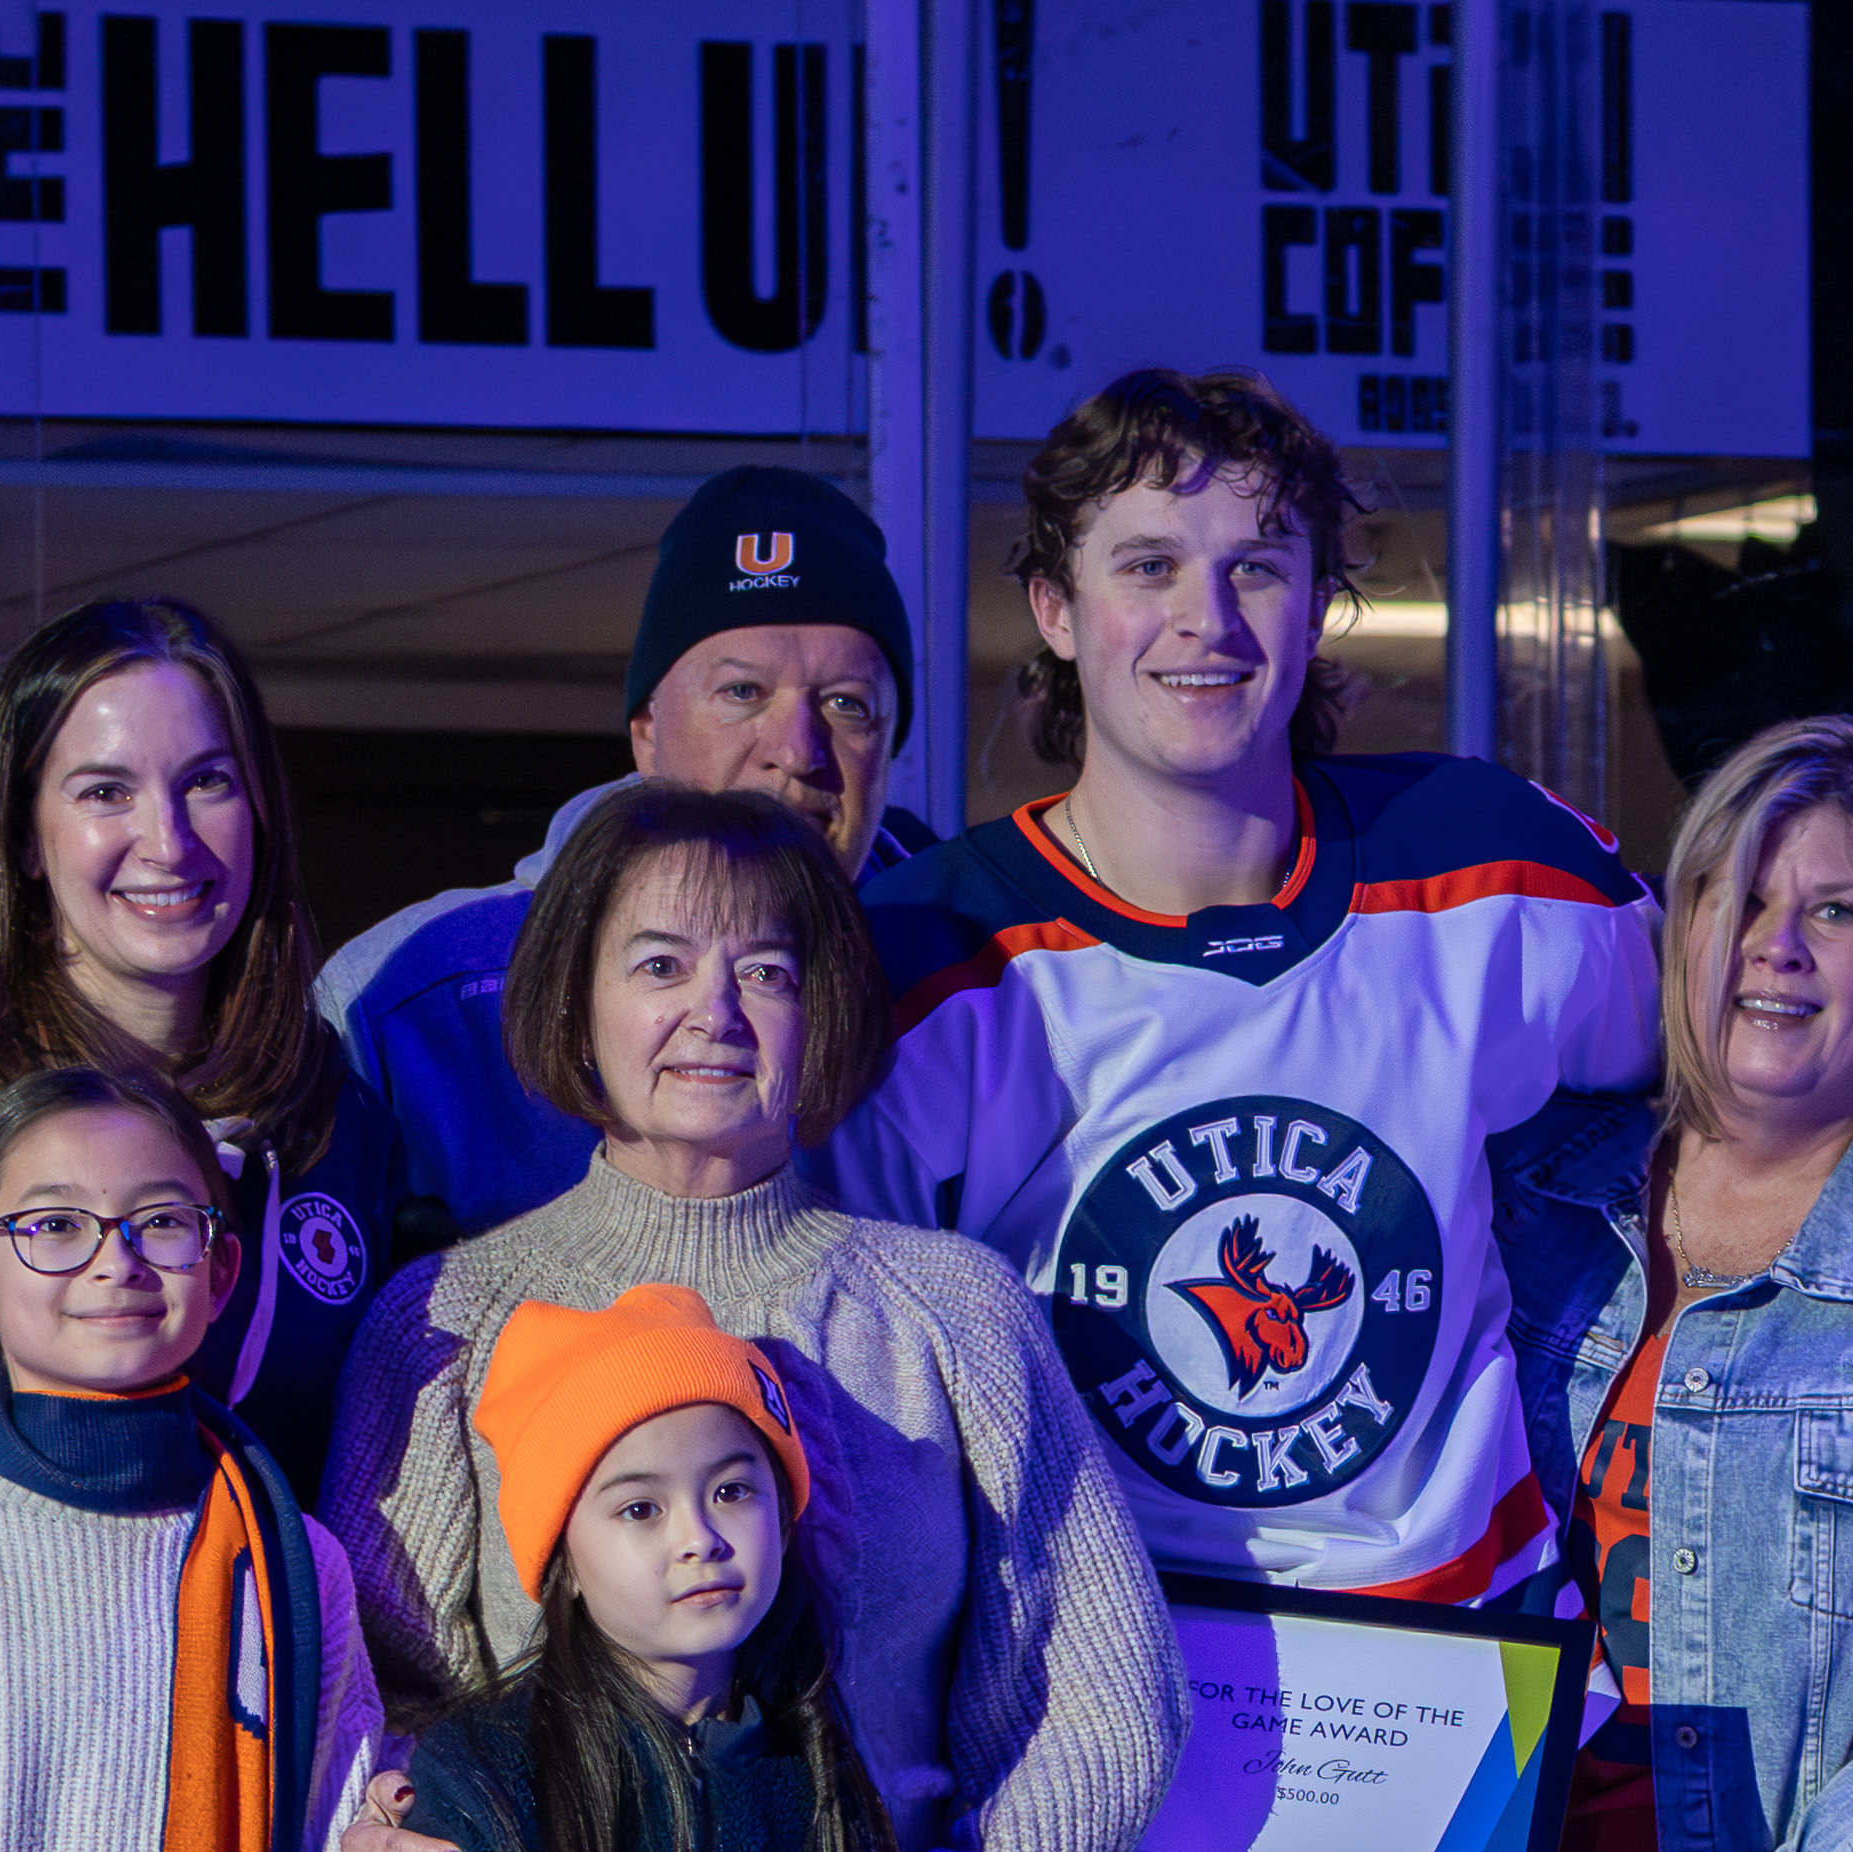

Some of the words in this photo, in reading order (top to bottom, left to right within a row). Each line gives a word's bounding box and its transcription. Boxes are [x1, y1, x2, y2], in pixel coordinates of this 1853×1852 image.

[101, 14, 656, 350] HELL
[735, 531, 795, 575] U
[728, 575, 800, 592] HOCKEY
[1127, 1115, 1374, 1216] UTICA
[290, 1201, 343, 1229] UTICA
[295, 1258, 356, 1296] HOCKEY
[1069, 1262, 1129, 1309] 19
[1372, 1268, 1434, 1314] 46
[1099, 1360, 1393, 1493] HOCKEY
[1245, 1686, 1293, 1708] THE
[1301, 1693, 1366, 1716] LOVE
[1374, 1701, 1408, 1721] OF
[1416, 1705, 1465, 1727] THE
[1232, 1712, 1304, 1735] GAME
[1310, 1721, 1409, 1747] AWARD
[1243, 1750, 1314, 1776] John
[1316, 1759, 1390, 1785] Gutt
[1276, 1786, 1340, 1805] $500.00
